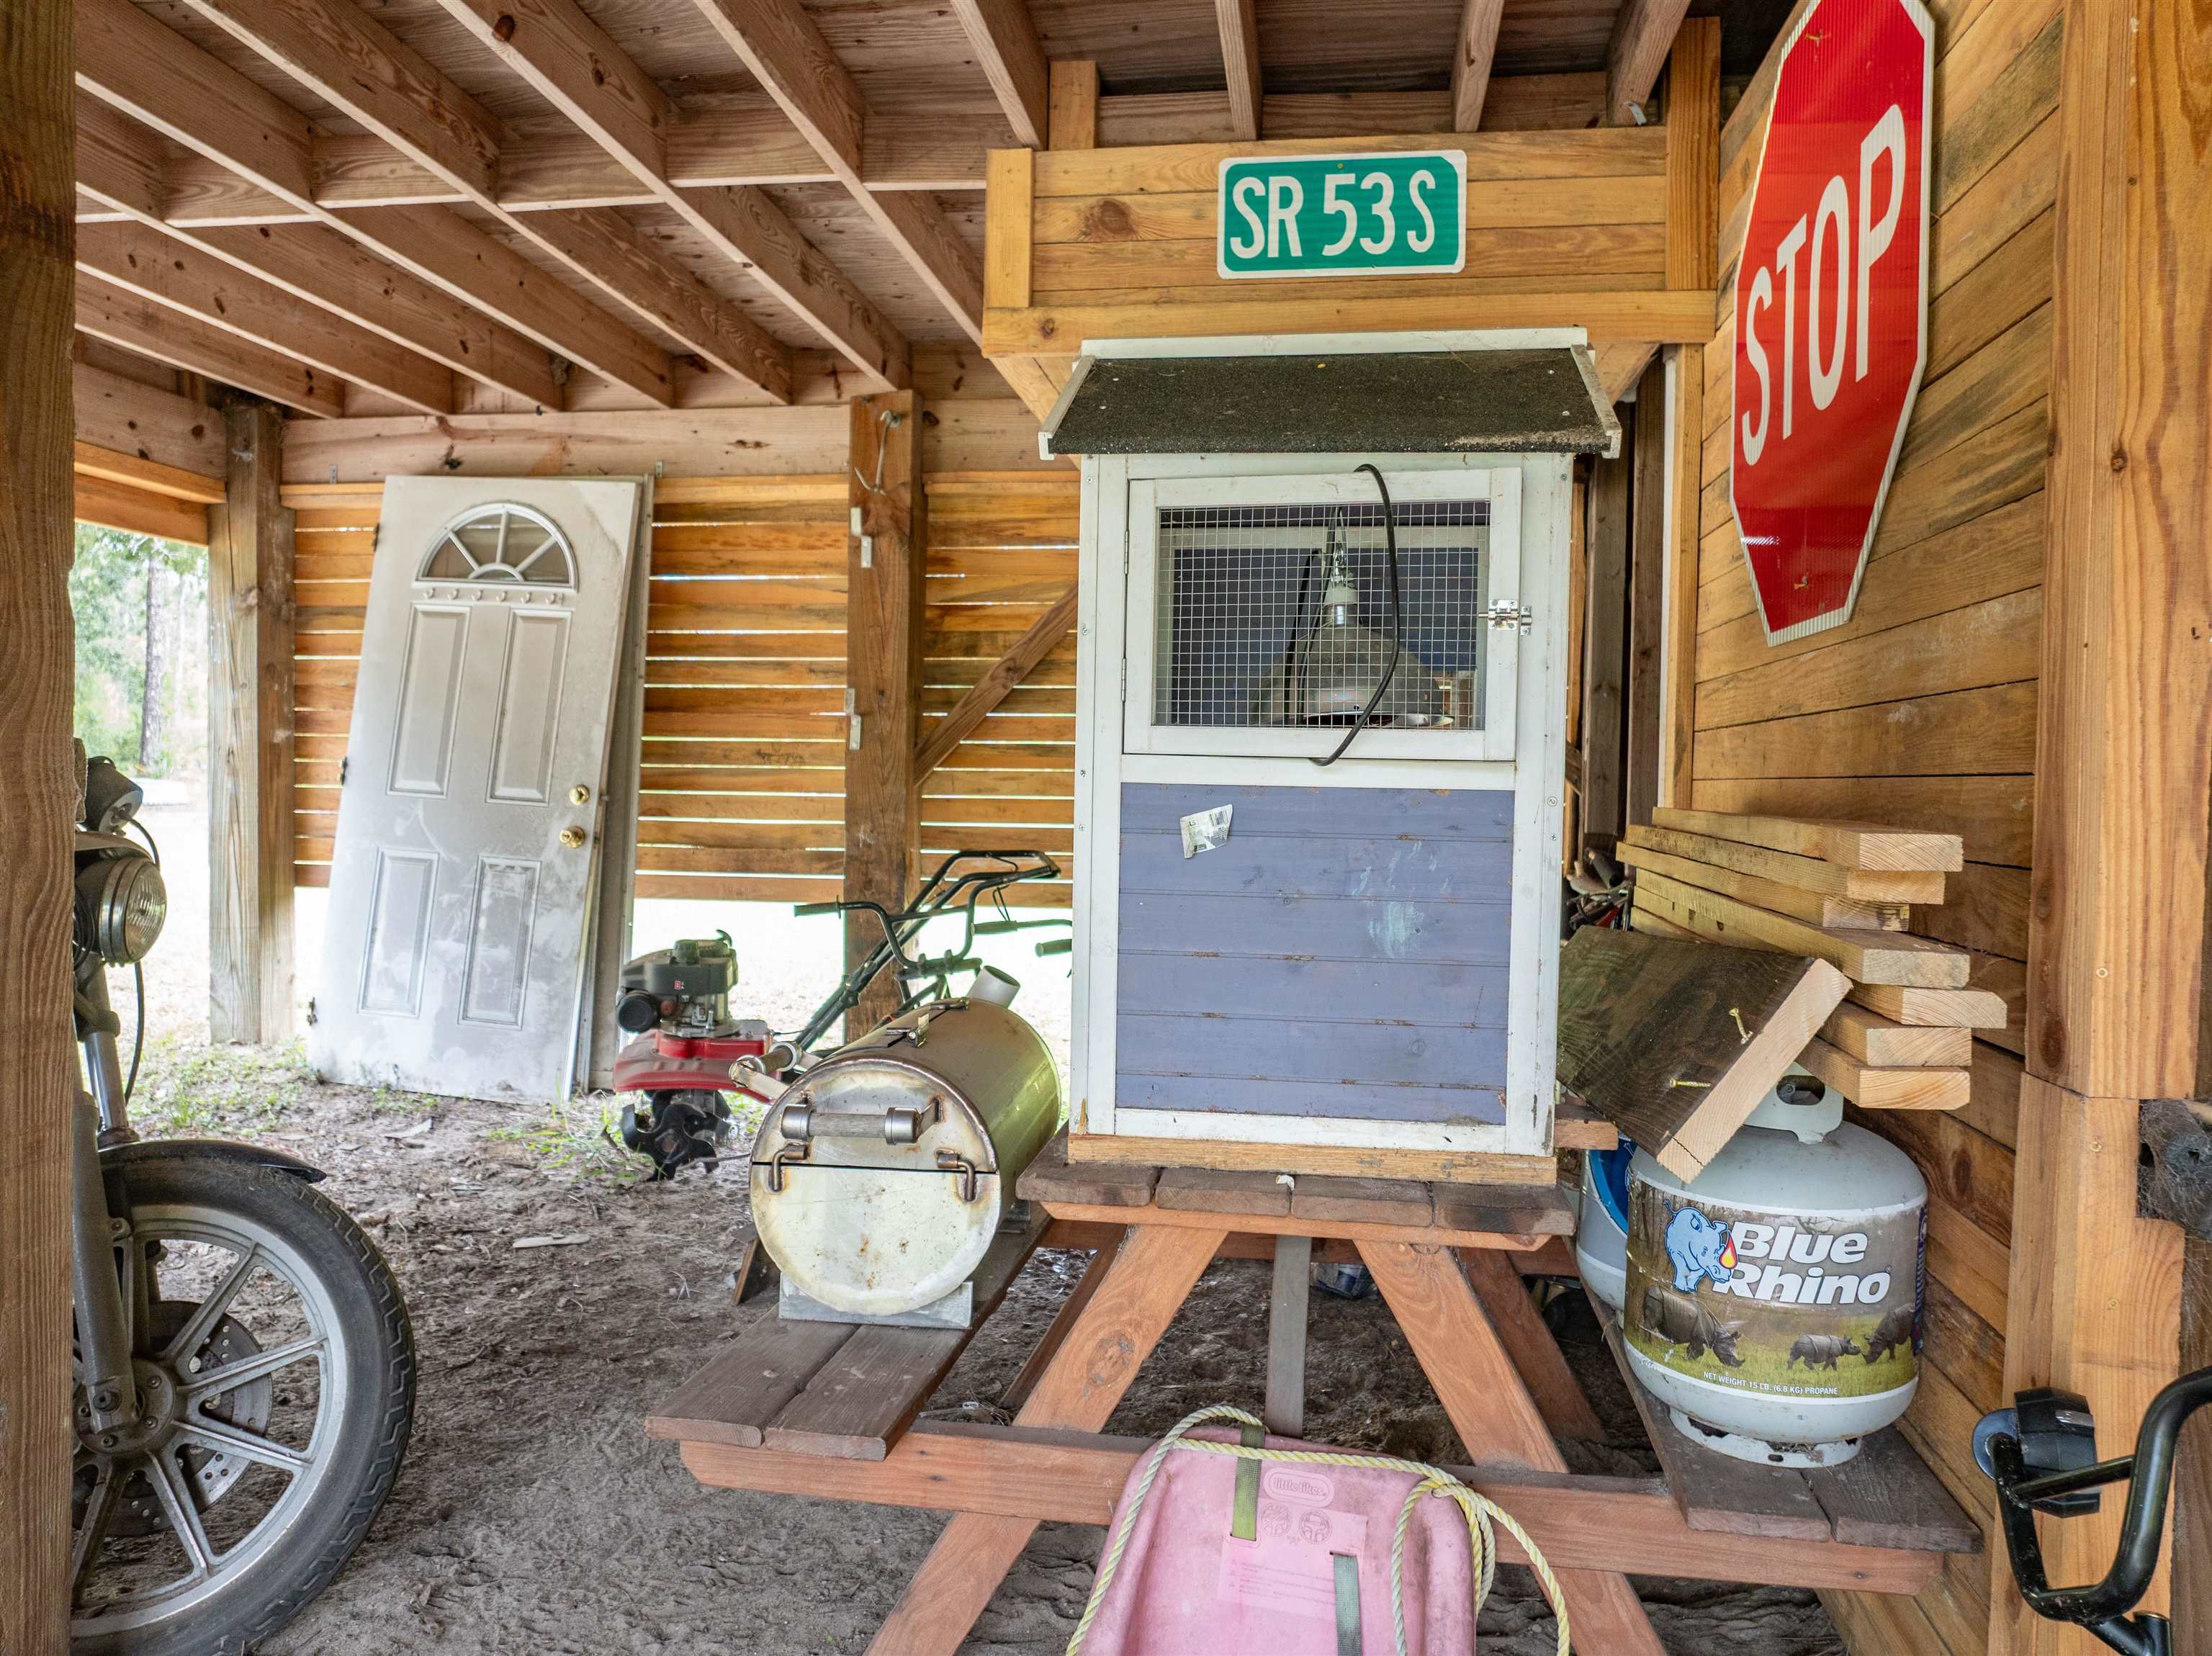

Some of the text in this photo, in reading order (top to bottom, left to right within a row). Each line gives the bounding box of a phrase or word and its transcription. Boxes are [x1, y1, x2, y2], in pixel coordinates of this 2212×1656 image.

[1230, 169, 1436, 259] SR 53 S
[1742, 104, 1906, 466] STOP
[1731, 1220, 1869, 1264] Blue
[1712, 1262, 1892, 1305] Rhino
[1704, 1371, 1717, 1380] NET
[1719, 1374, 1746, 1386] WEIGHT
[1773, 1384, 1788, 1392] (6.8
[1790, 1385, 1803, 1394] KG)
